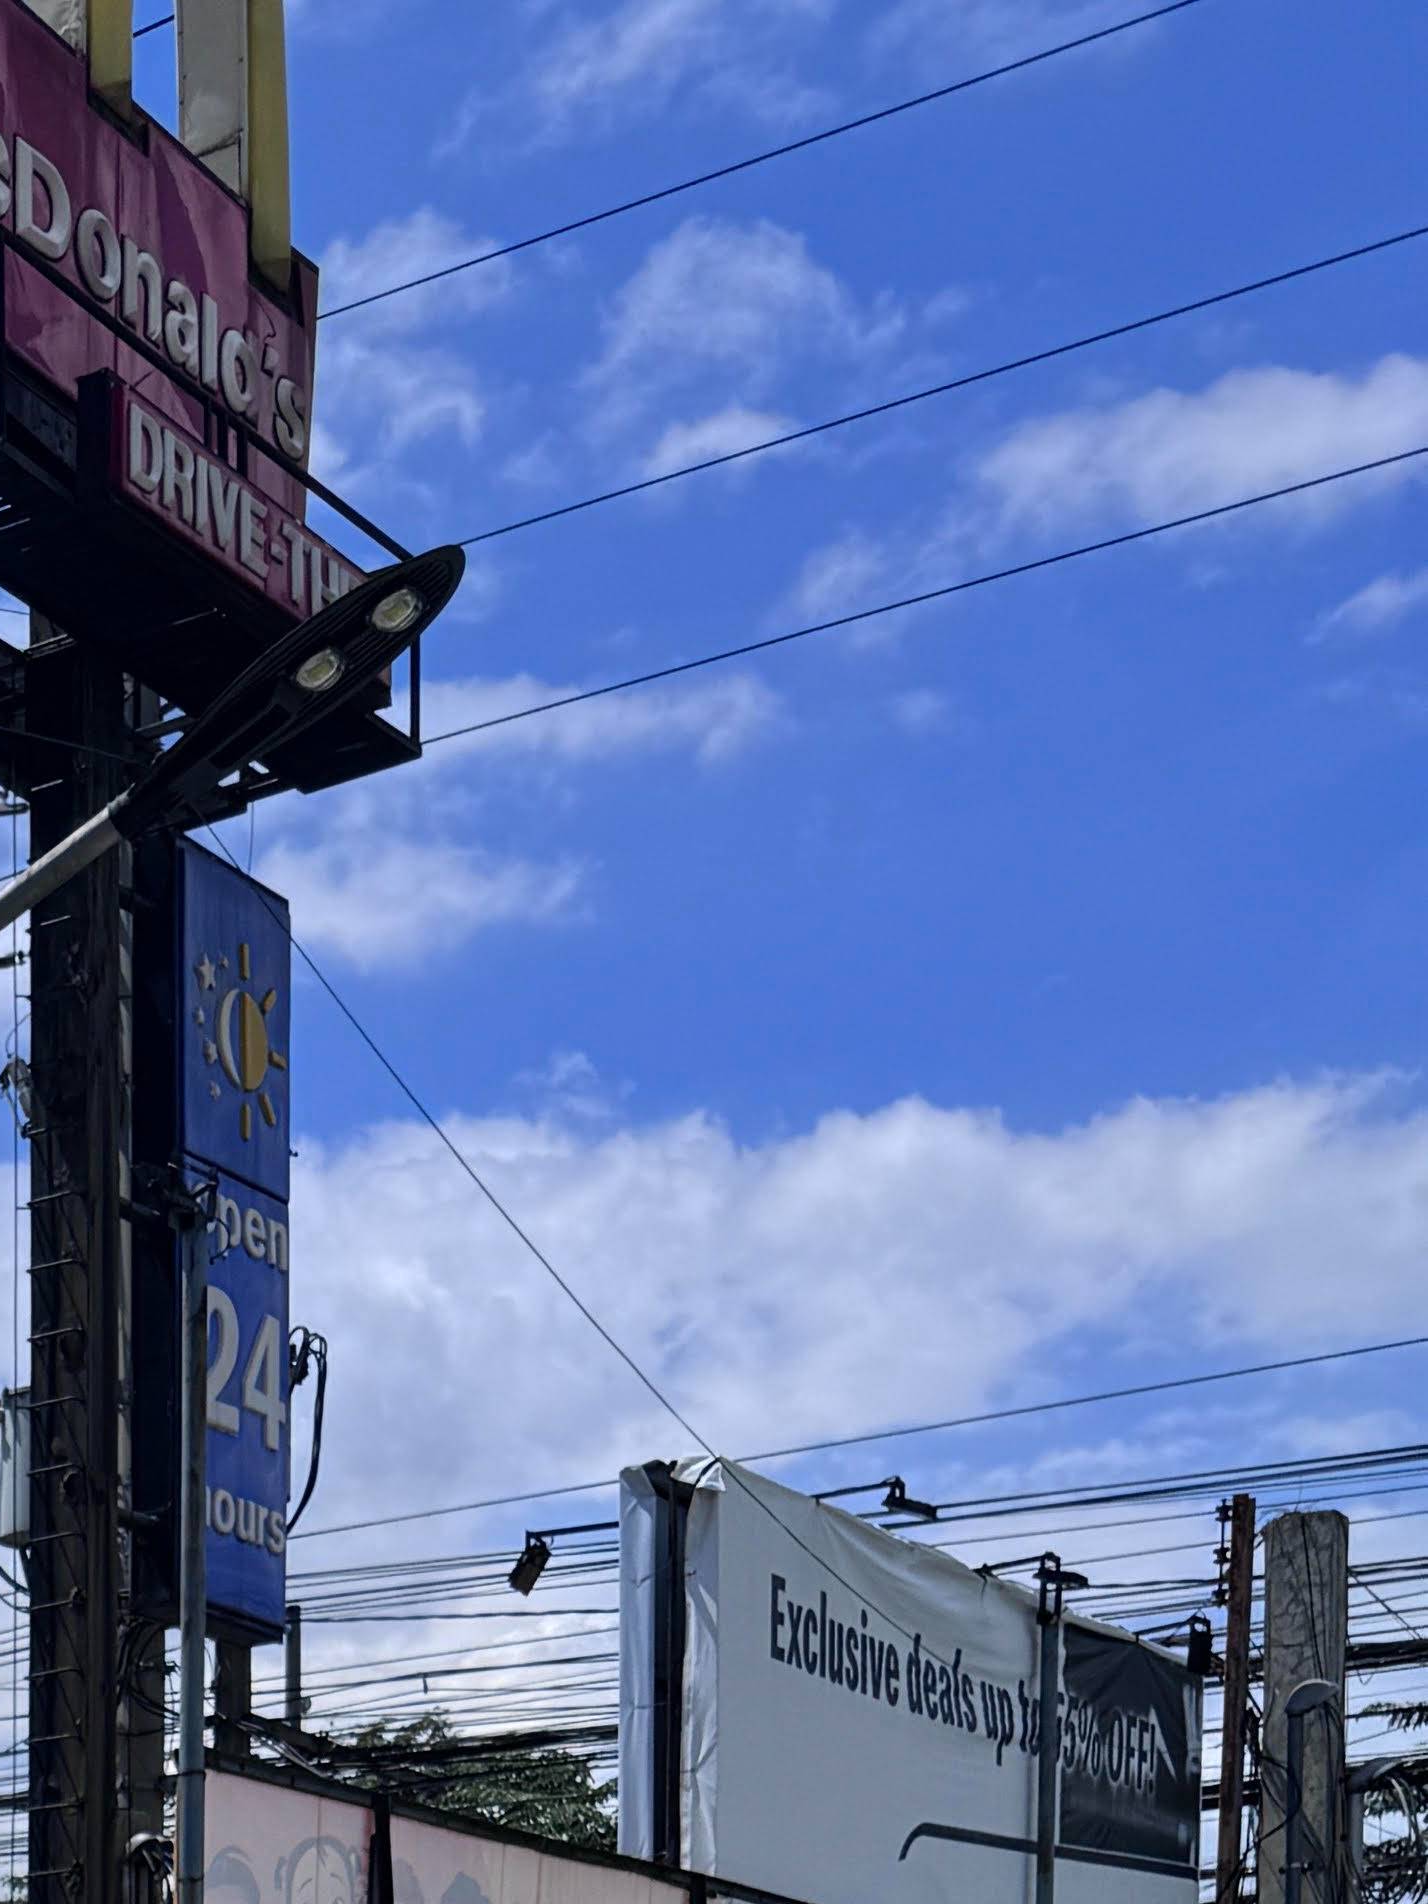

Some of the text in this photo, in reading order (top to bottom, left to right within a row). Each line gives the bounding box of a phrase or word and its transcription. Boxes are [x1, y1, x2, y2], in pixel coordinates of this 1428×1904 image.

[127, 397, 364, 617] DRIVE-TH
[206, 1284, 286, 1452] 24
[206, 1486, 285, 1556] ours
[770, 1572, 900, 1707] Exclusive
[906, 1632, 977, 1733] deals
[980, 1680, 1014, 1767] up
[1106, 1707, 1156, 1795] OFF!
